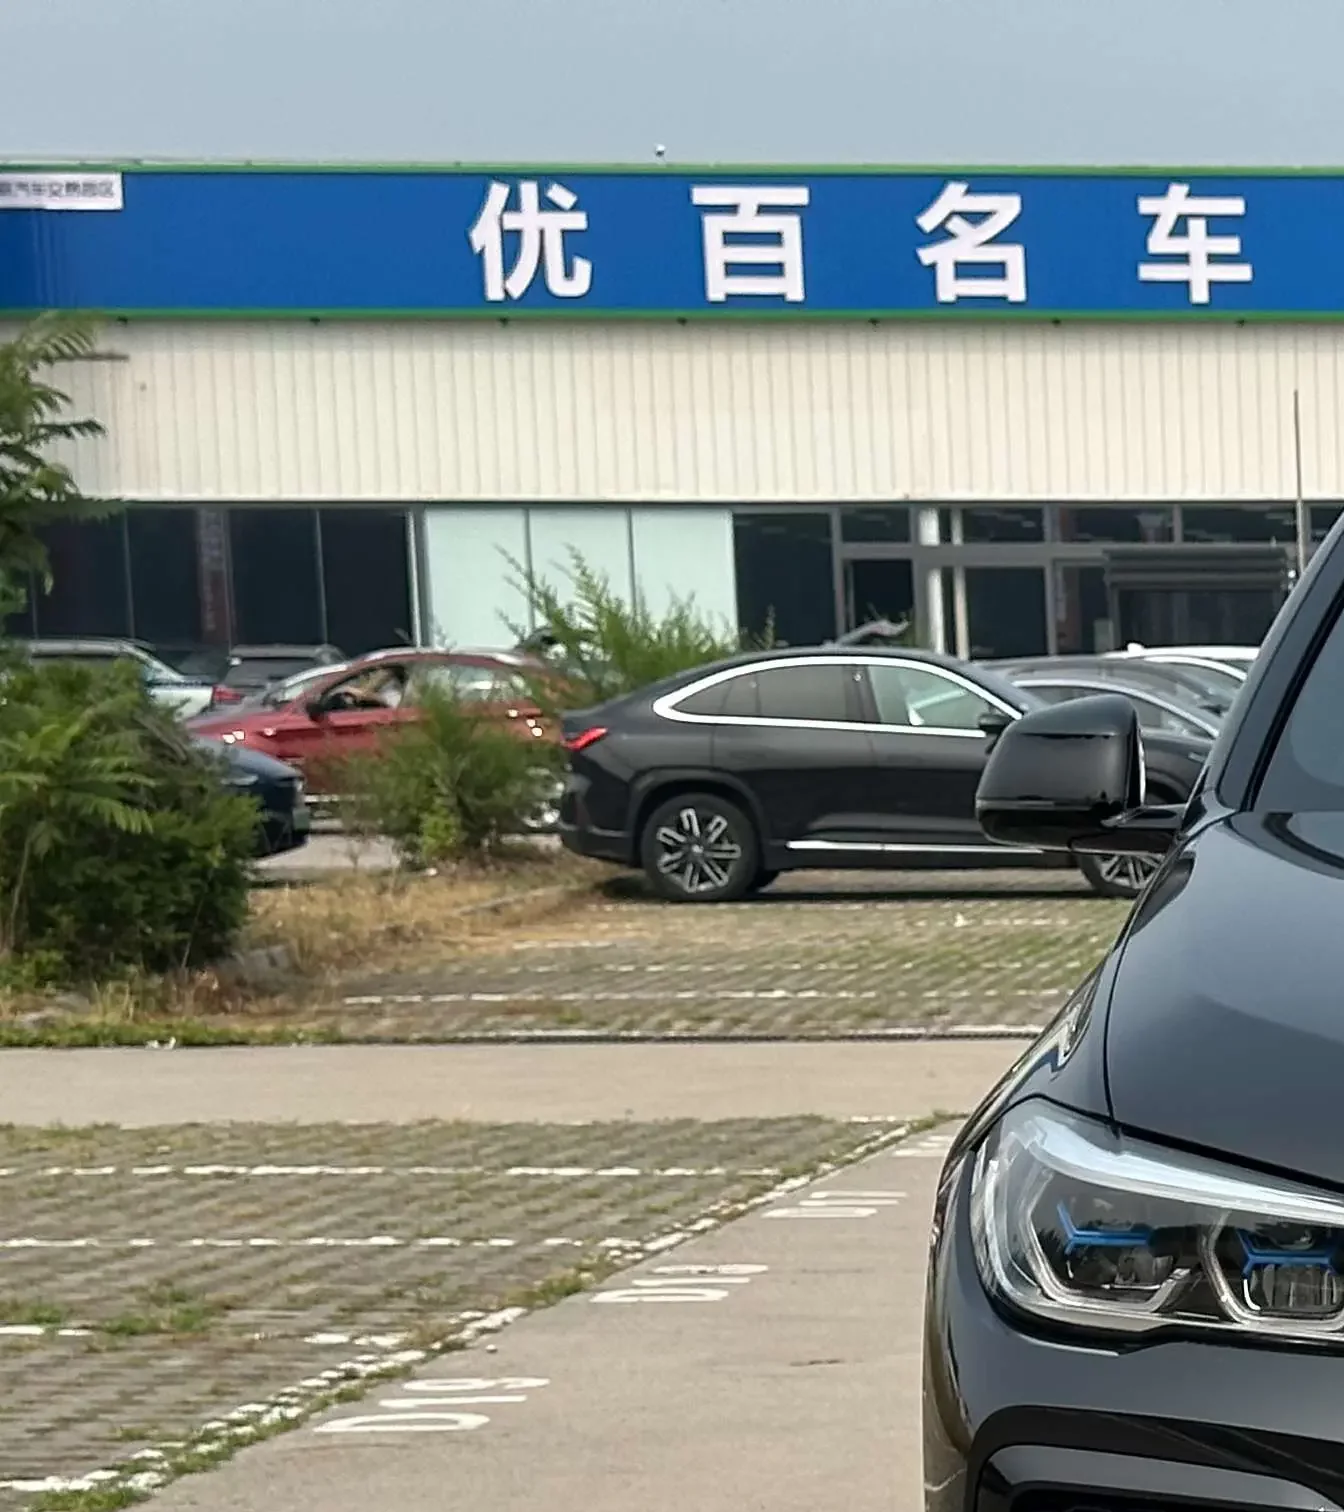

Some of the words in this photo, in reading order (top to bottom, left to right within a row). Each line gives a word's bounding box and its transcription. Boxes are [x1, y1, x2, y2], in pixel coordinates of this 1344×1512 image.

[469, 180, 1253, 304] 优百名车
[312, 1377, 550, 1432] D19
